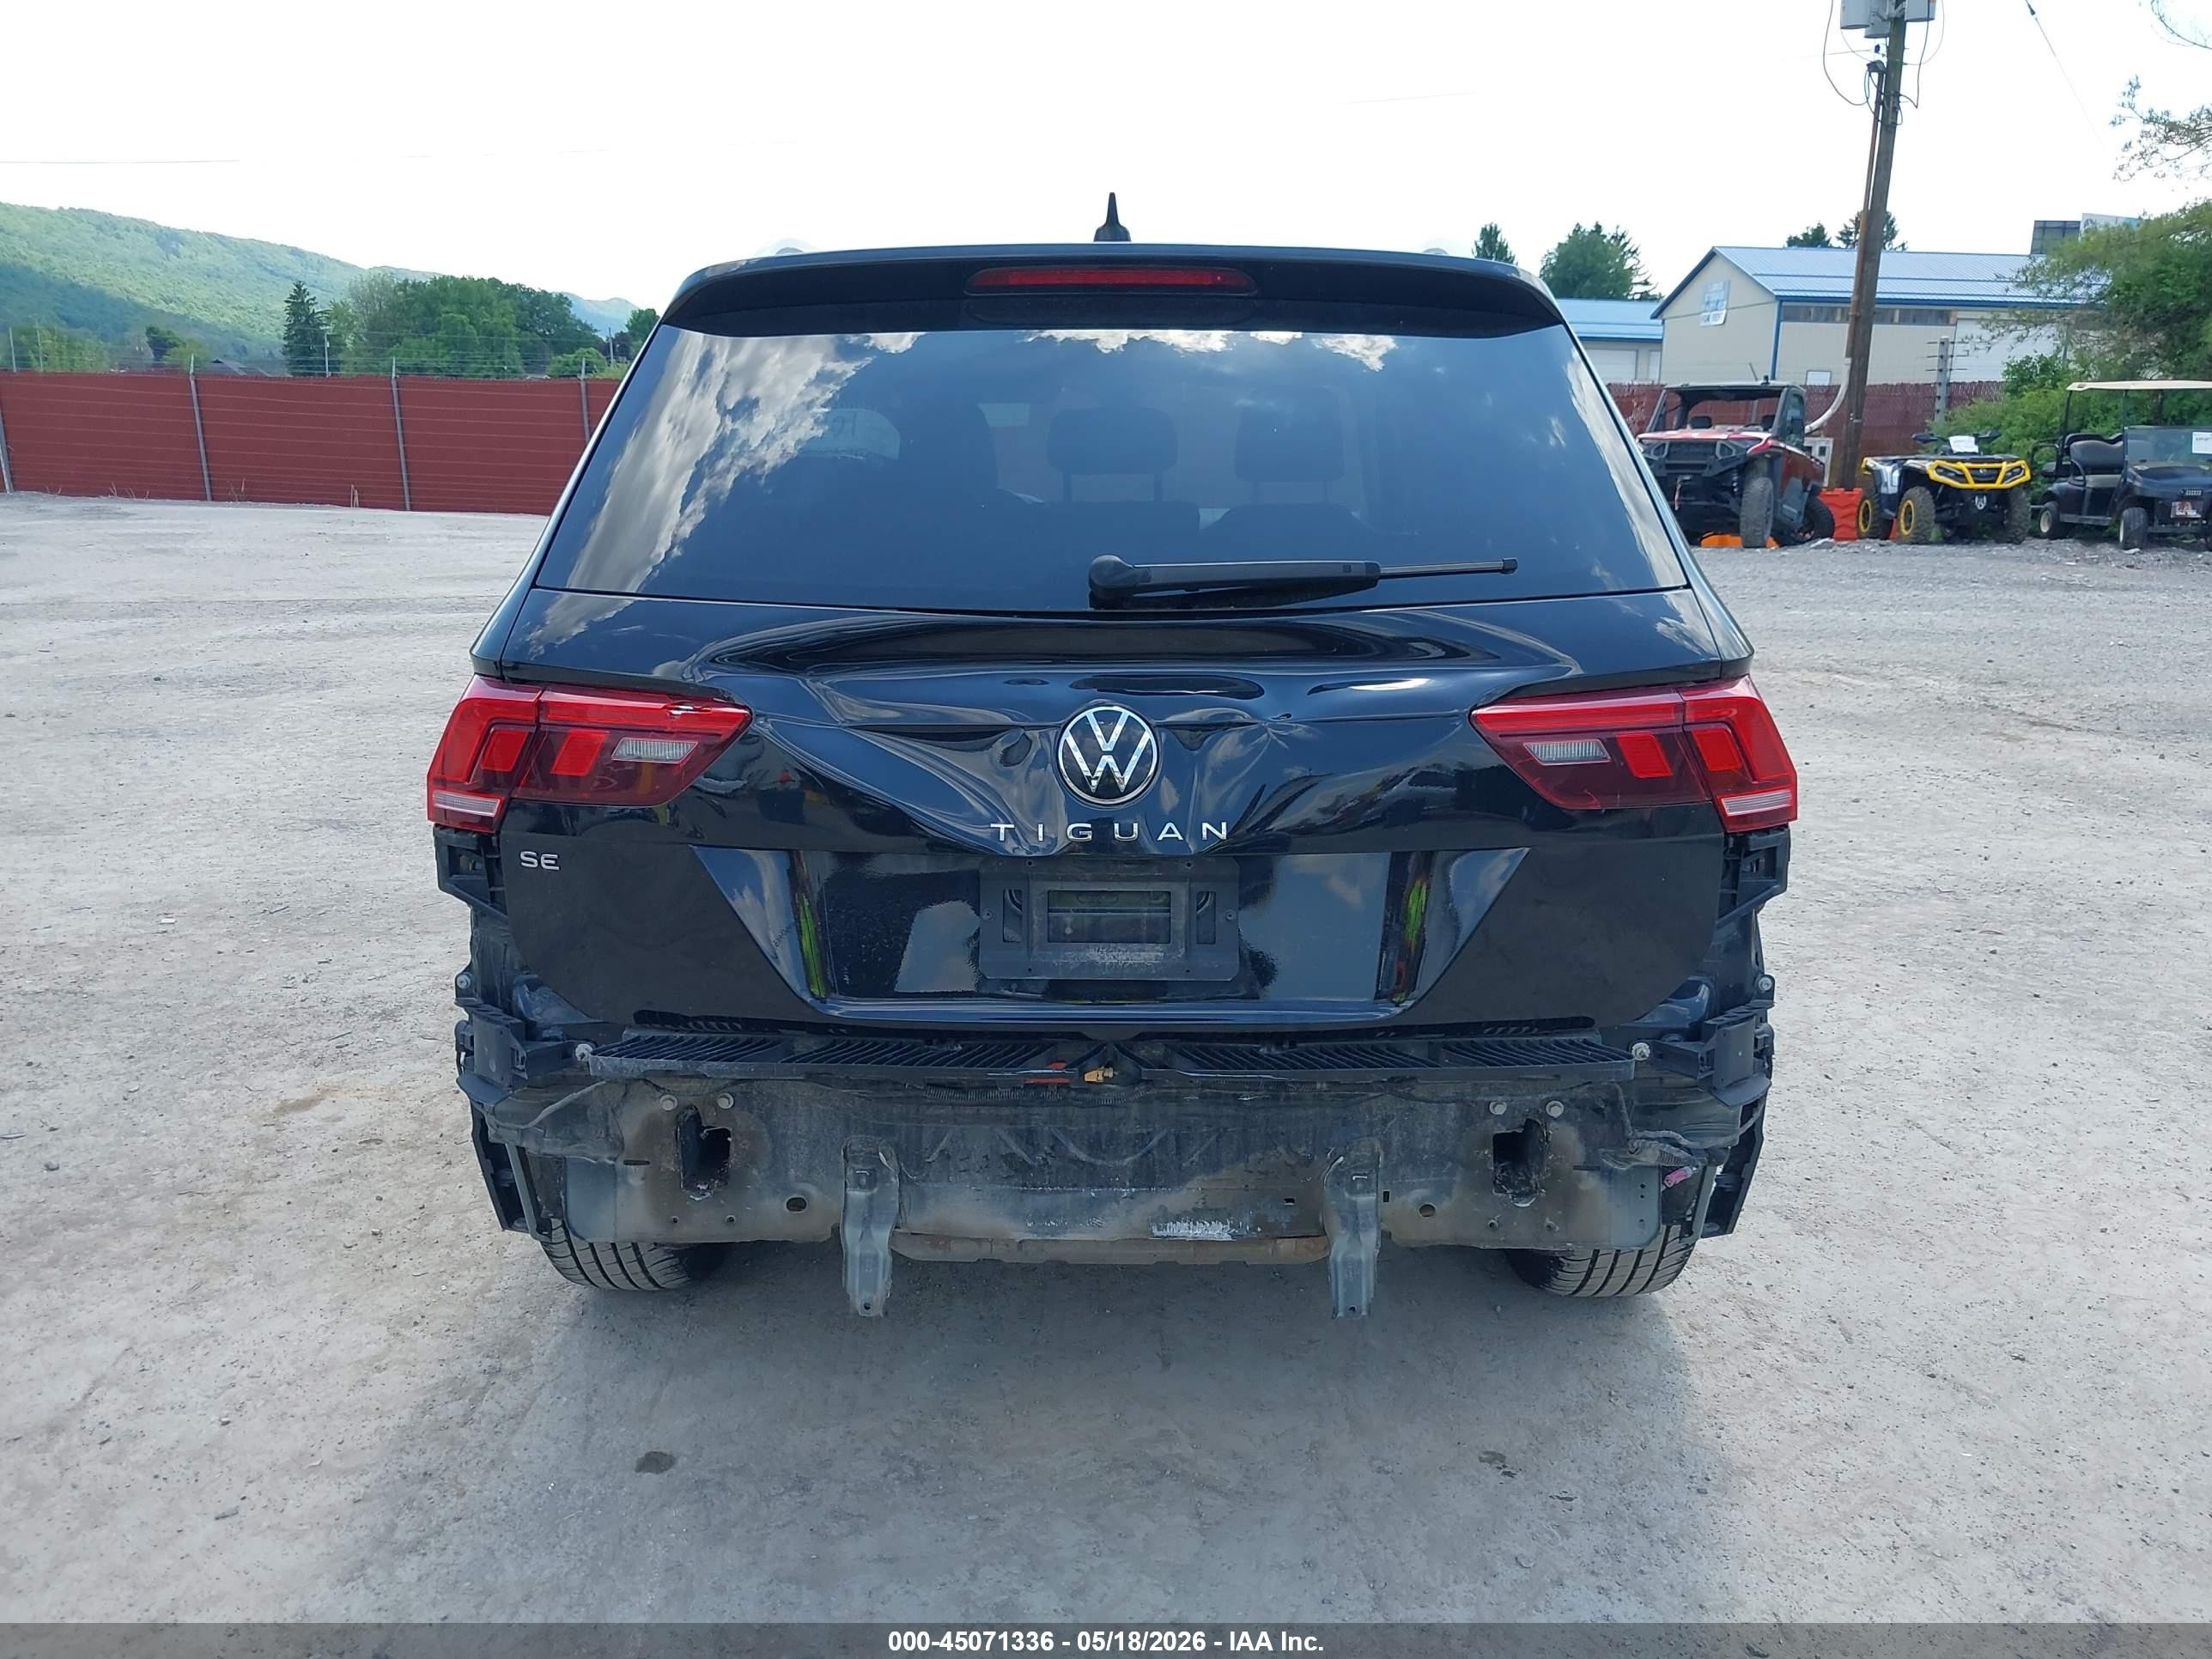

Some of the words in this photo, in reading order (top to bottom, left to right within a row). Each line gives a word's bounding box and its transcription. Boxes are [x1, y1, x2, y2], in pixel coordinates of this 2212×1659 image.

[1061, 707, 1153, 795] VW
[990, 821, 1228, 842] TIGUAN
[520, 850, 560, 871] SE
